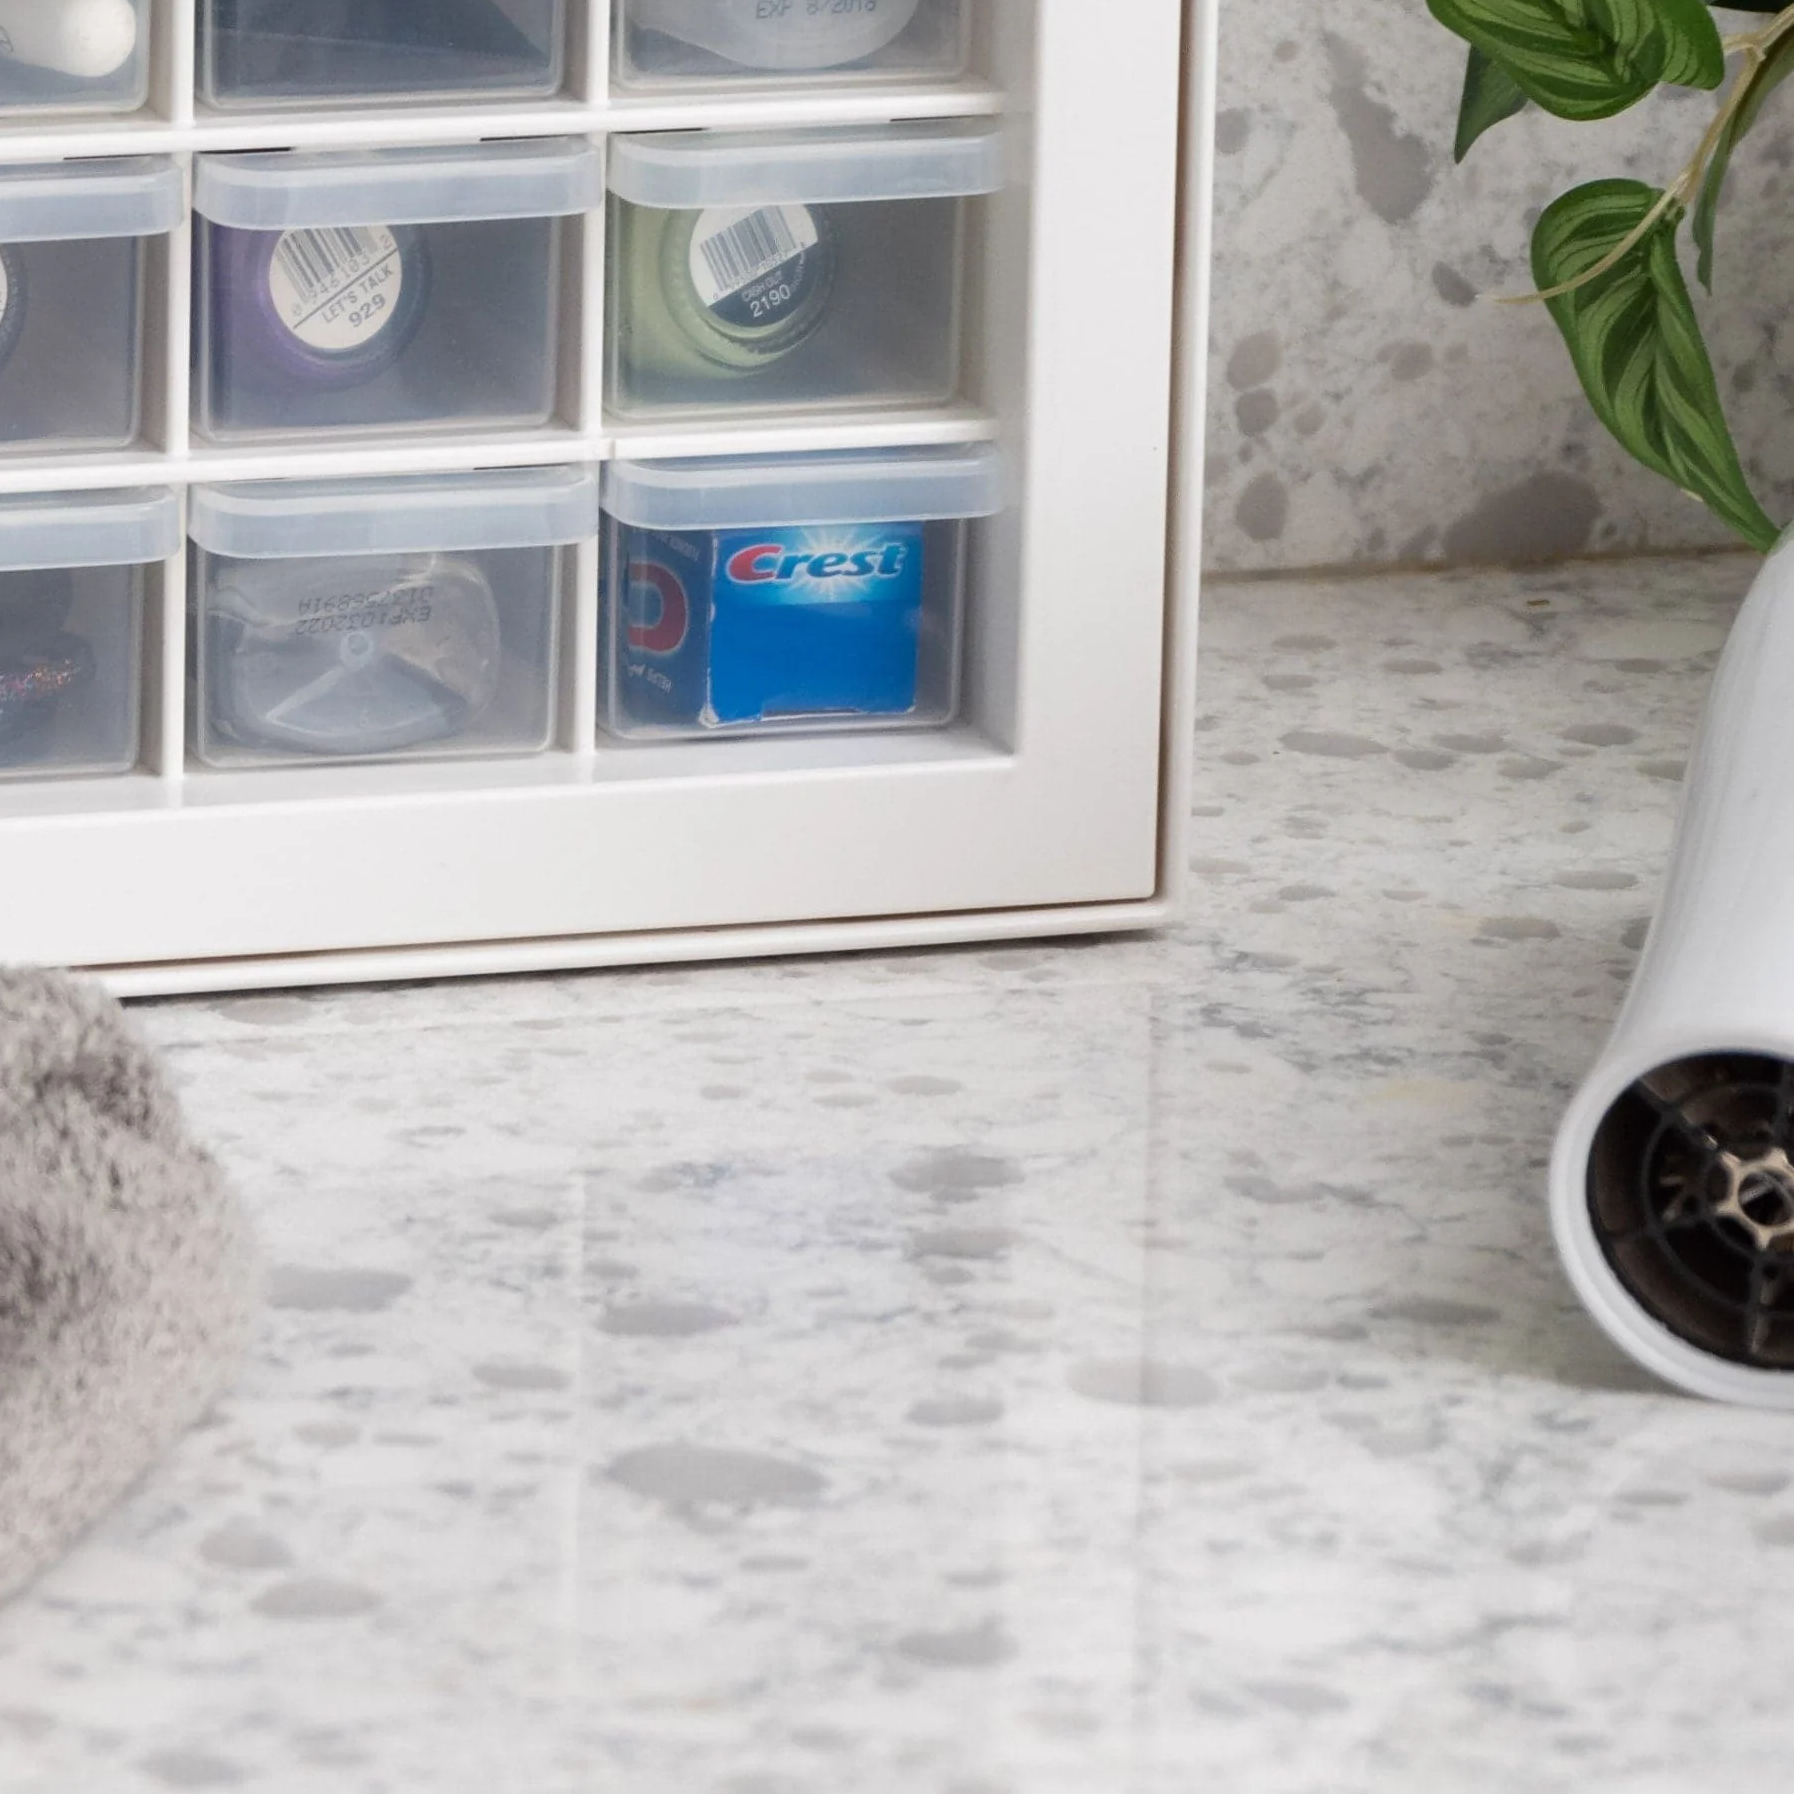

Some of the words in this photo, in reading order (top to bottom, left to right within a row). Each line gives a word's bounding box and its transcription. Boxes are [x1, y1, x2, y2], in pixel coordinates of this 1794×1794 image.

[321, 290, 359, 324] LET'S
[359, 263, 394, 294] TALK
[348, 293, 386, 328] 929
[749, 283, 792, 318] 2190
[725, 541, 910, 586] Crest
